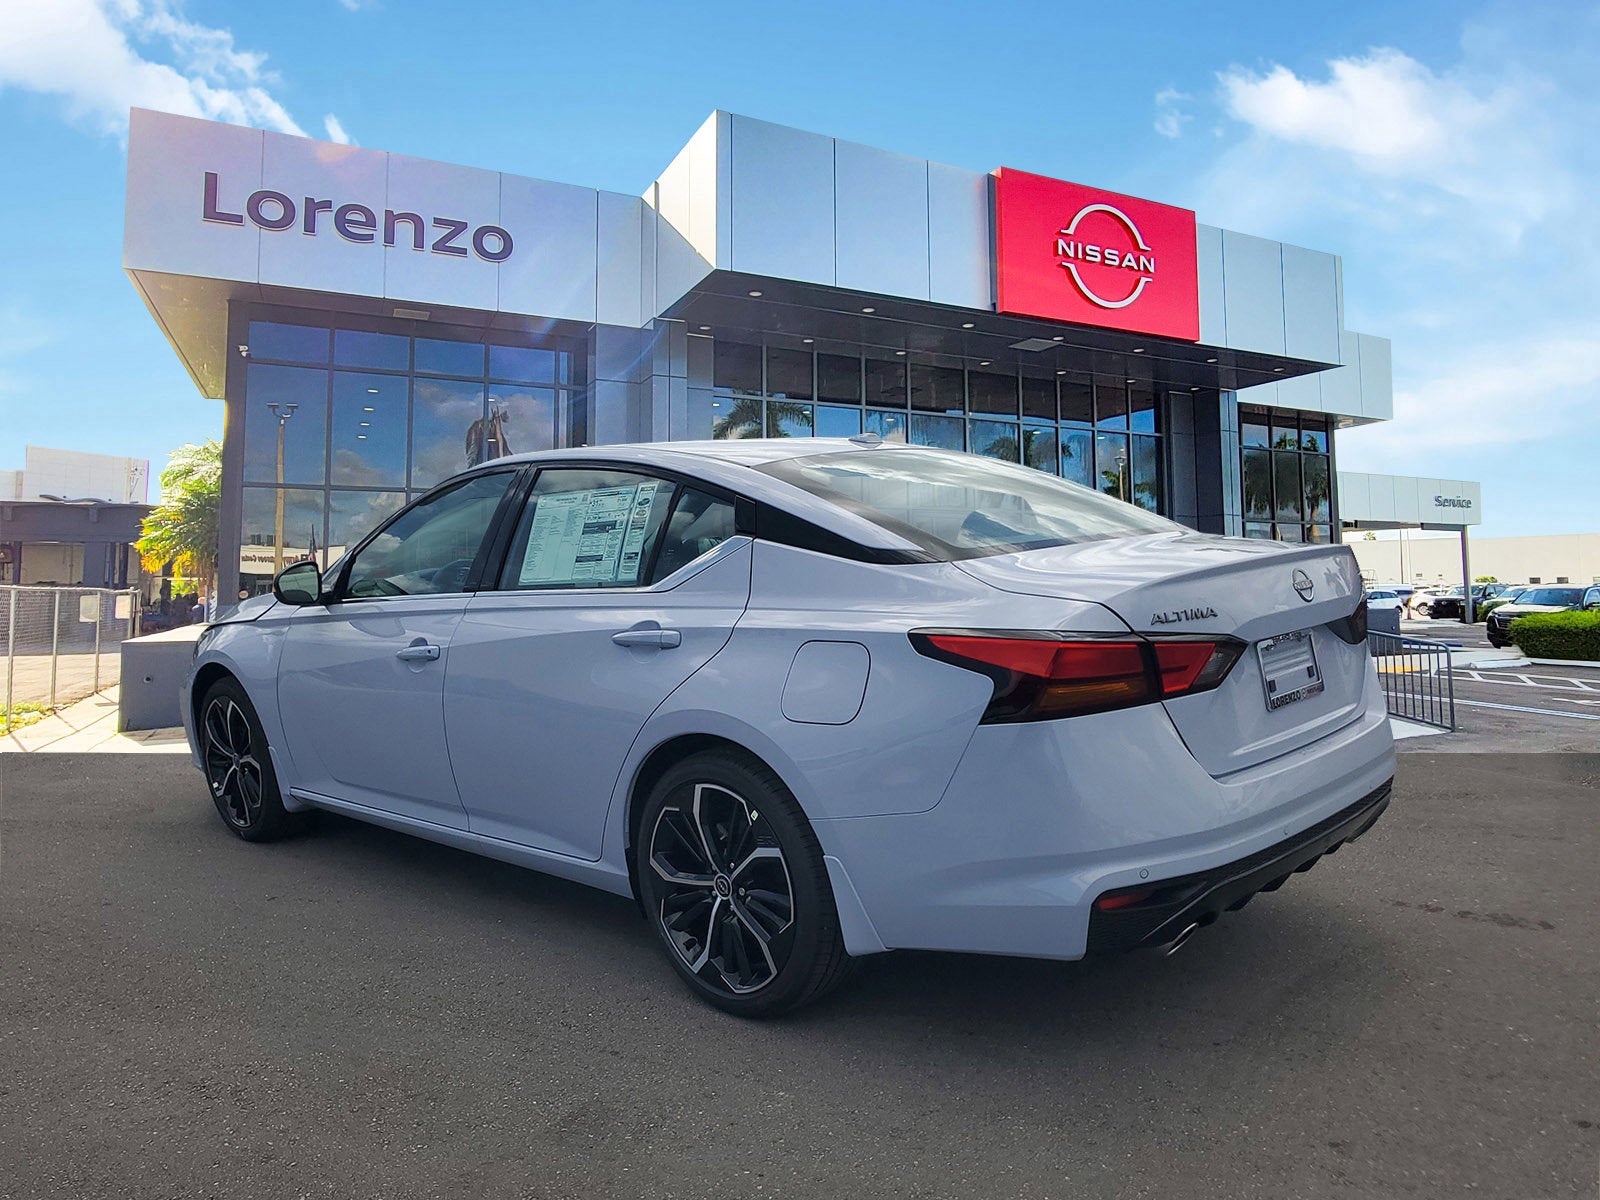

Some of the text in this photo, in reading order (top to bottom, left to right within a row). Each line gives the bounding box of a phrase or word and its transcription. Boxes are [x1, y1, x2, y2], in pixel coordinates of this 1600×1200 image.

[202, 171, 514, 262] Lorenzo
[1057, 238, 1154, 273] NISSAN
[1434, 495, 1472, 508] Service
[1151, 607, 1218, 625] ALTIMA
[1270, 690, 1301, 709] LORENZO
